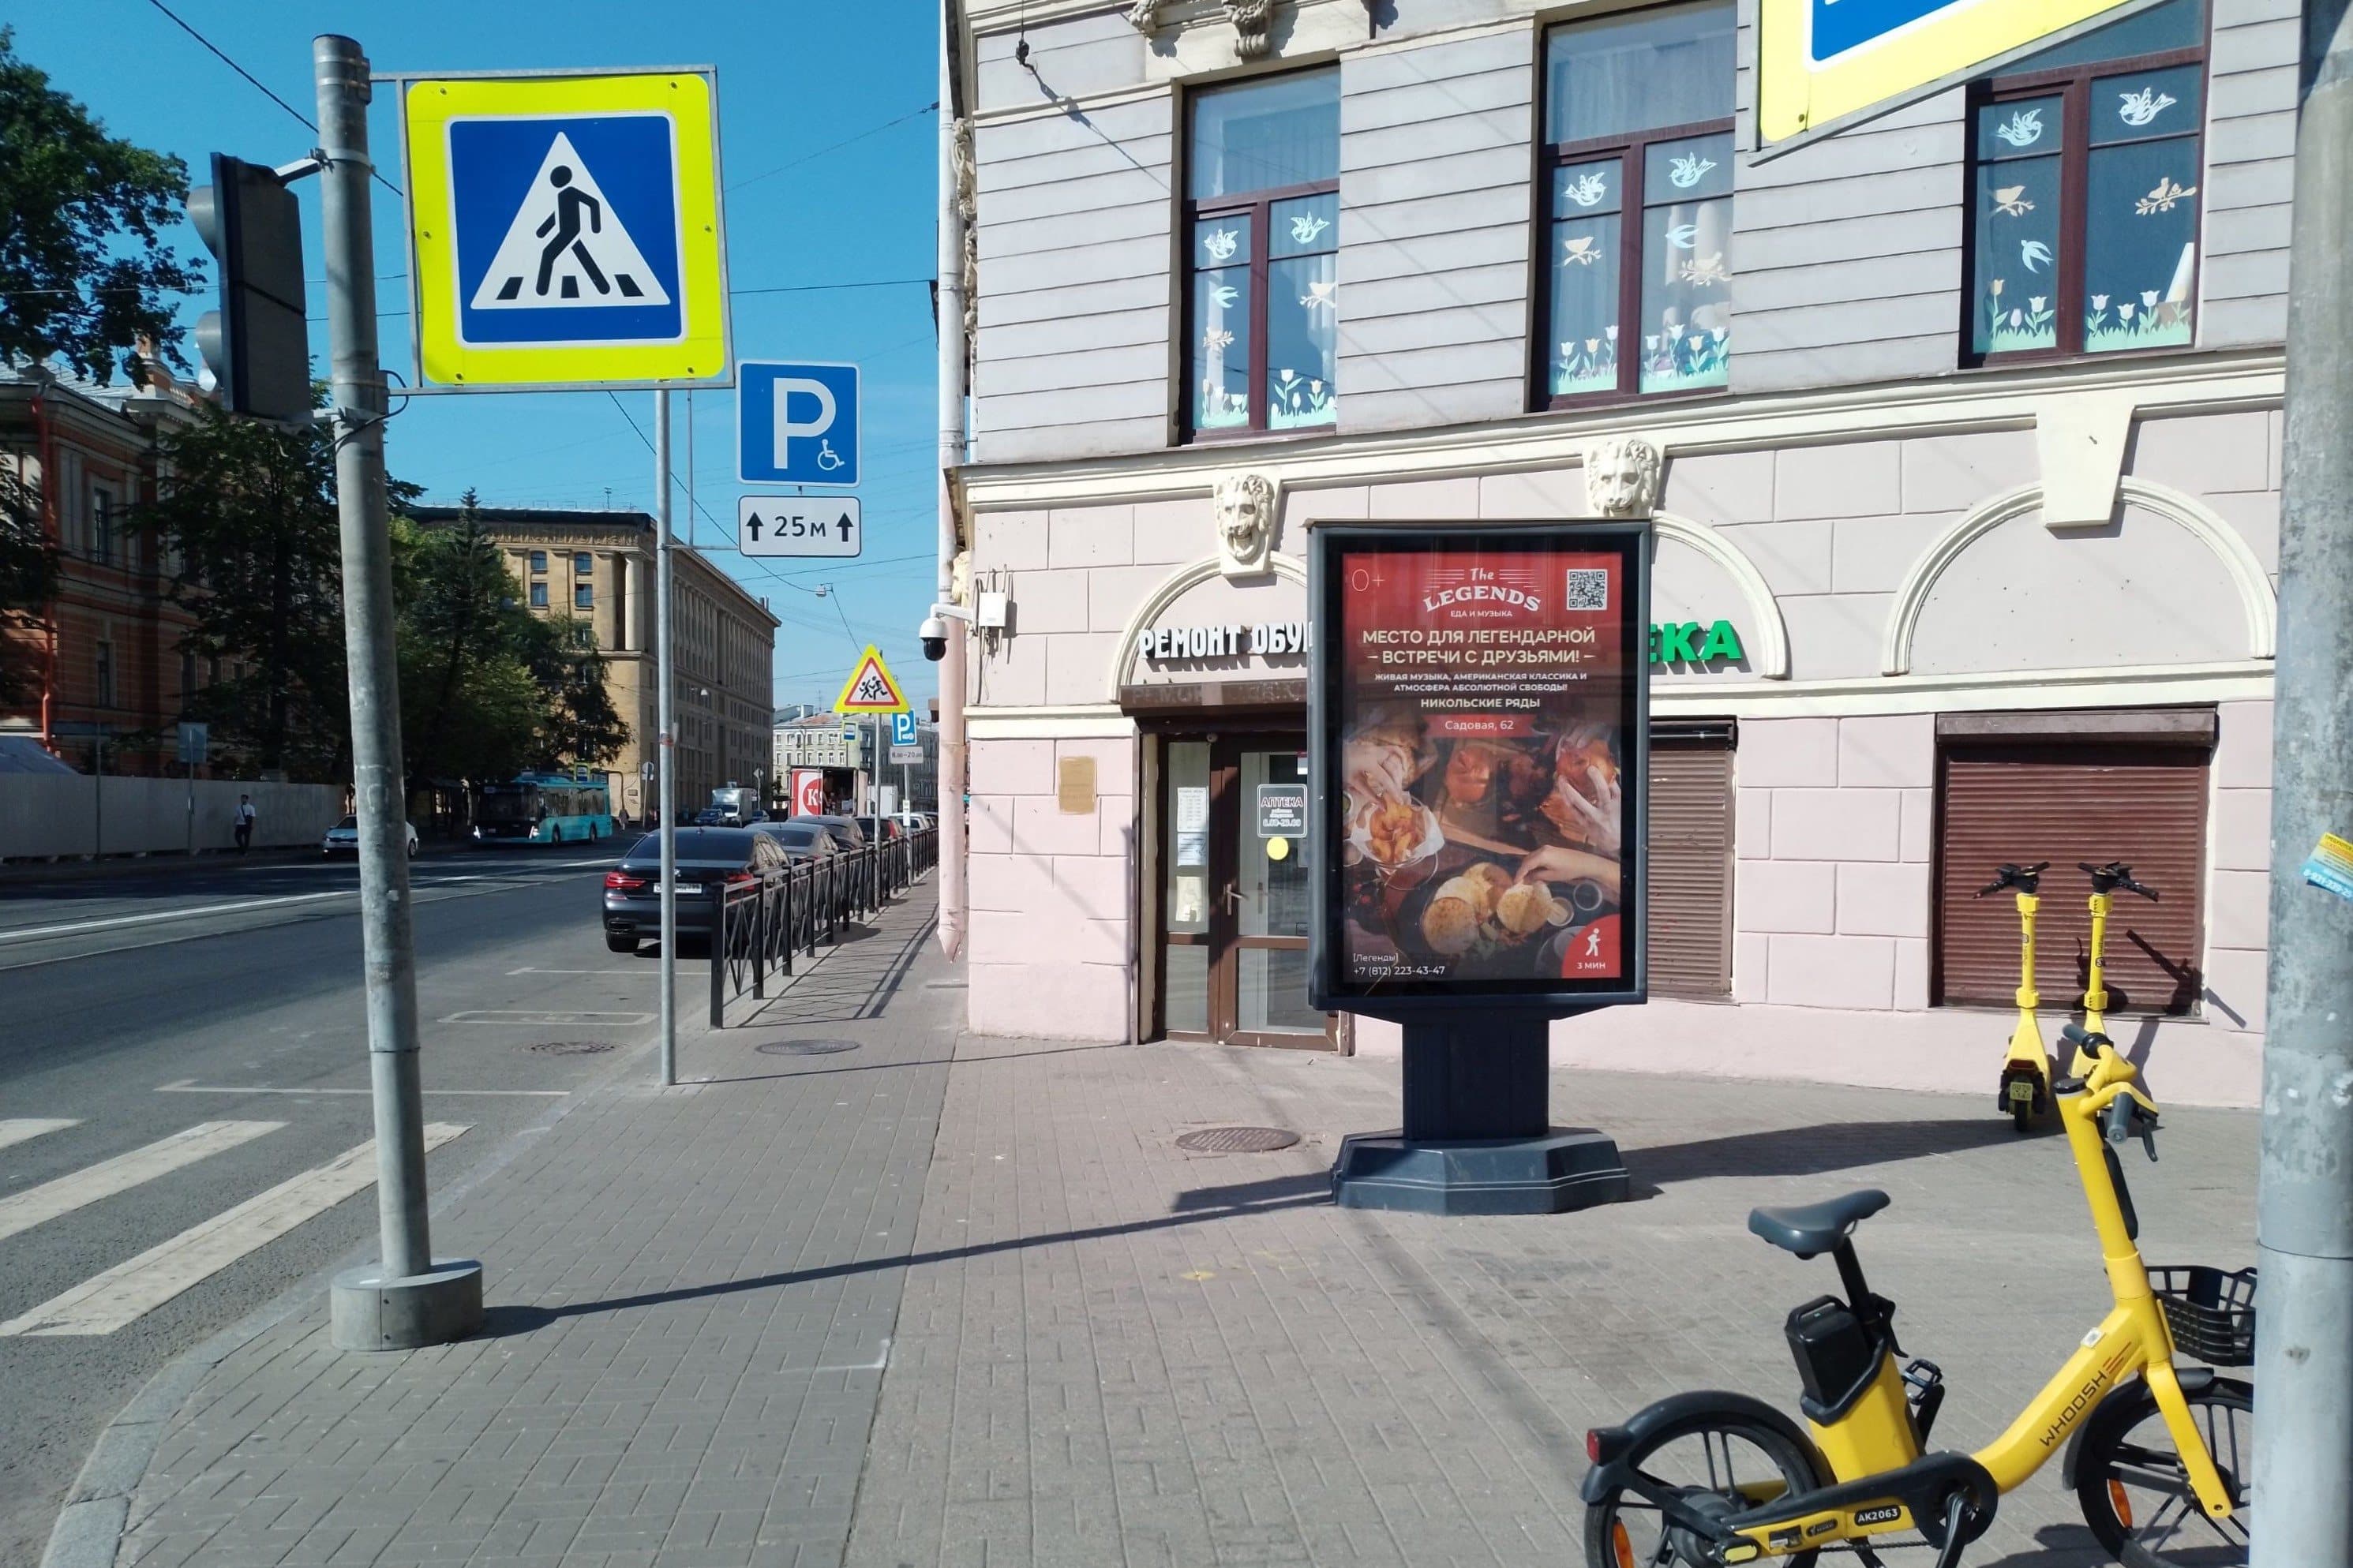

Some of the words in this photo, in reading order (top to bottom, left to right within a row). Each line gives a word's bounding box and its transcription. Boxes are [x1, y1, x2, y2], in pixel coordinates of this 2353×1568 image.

[773, 377, 837, 470] P
[1351, 568, 1386, 592] 0+
[1470, 567, 1495, 581] The
[1422, 586, 1542, 612] LEGENDS
[1477, 609, 1513, 618] МУЗЫКА
[1137, 624, 1242, 660] РЕМОНТ
[1362, 630, 1423, 644] МЕСТО
[1426, 630, 1464, 646] ДЛЯ
[1467, 626, 1595, 646] ЛЕГЕНДАРНОЙ
[1382, 650, 1461, 664] ВСТРЕЧИ
[1464, 649, 1478, 664] С
[1481, 649, 1579, 666] ДРУЗЬЯМИ!
[1410, 673, 1452, 682] МУЗЫКА,
[1452, 682, 1517, 692] АБСОЛЮТНОЙ
[1519, 683, 1568, 692] СВОБОДЫ!
[1421, 698, 1503, 708] НИКОЛЬСКИЕ
[1505, 698, 1541, 709] РЯДЫ
[897, 713, 911, 741] P
[1444, 720, 1497, 732] Садовая,
[1500, 720, 1515, 730] 62
[1261, 796, 1303, 808] АПТЕКА
[1353, 967, 1366, 975] +7
[1369, 965, 1391, 978] (812)
[1394, 965, 1446, 975] 223-43-47
[2040, 1370, 2108, 1446] WHOOSH
[1857, 1507, 1899, 1524] AK2063
